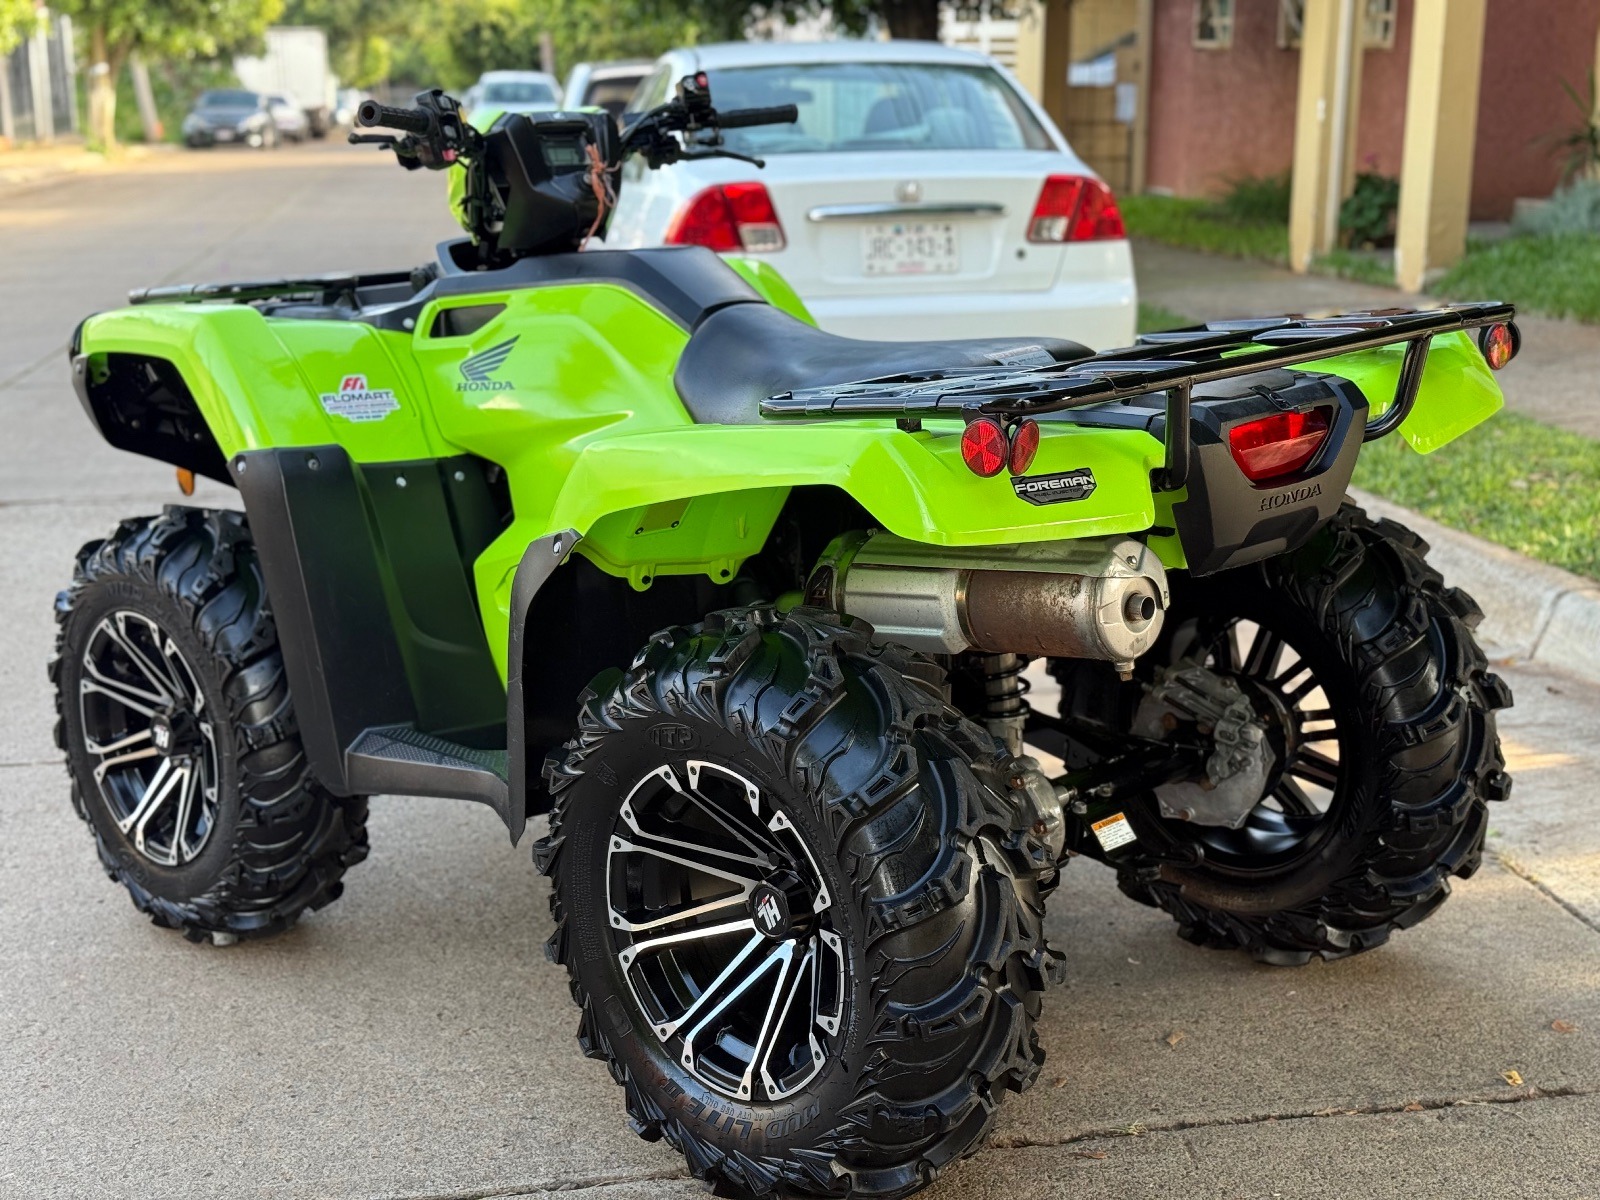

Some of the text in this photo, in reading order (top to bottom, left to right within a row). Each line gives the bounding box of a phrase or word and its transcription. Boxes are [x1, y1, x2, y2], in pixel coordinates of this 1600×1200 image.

[456, 381, 515, 392] HONDA
[1014, 475, 1095, 493] FOREMAN
[1258, 484, 1322, 512] HONDA
[700, 1093, 719, 1109] ONLY
[682, 1097, 753, 1140] LITE
[720, 1104, 735, 1117] USE
[765, 1095, 821, 1139] MUD
